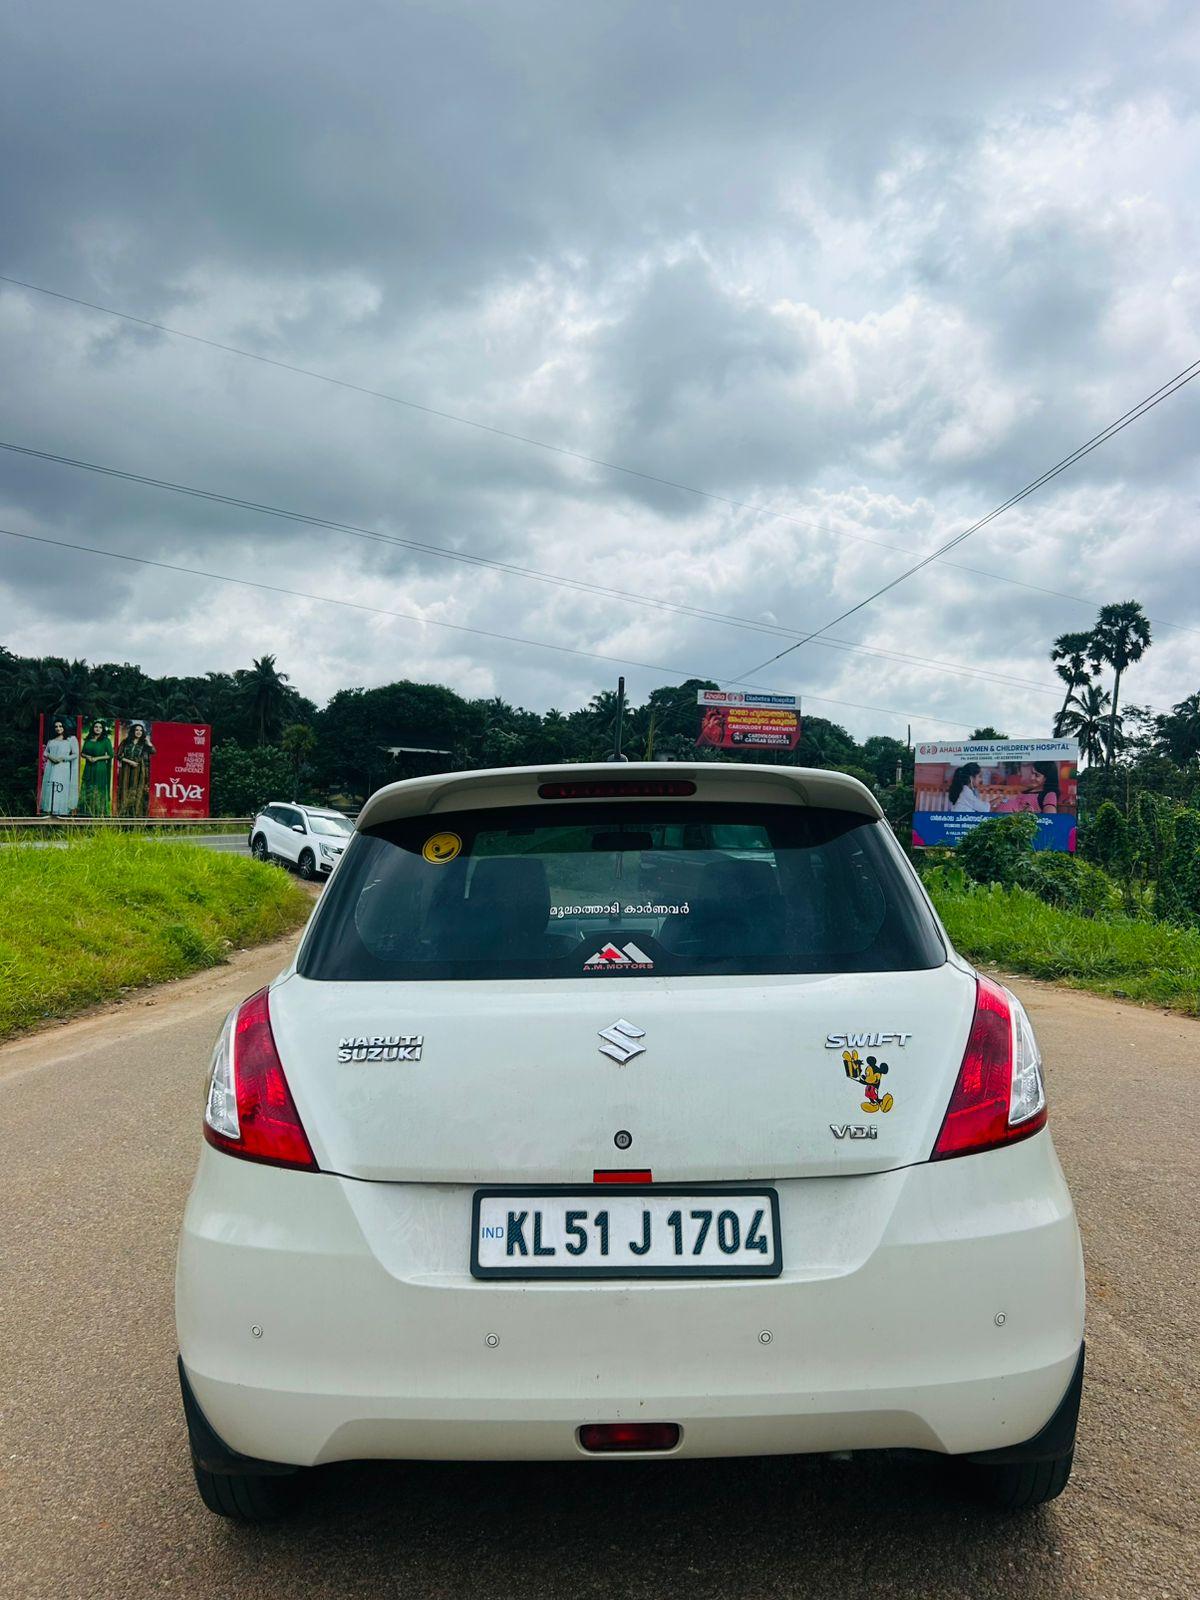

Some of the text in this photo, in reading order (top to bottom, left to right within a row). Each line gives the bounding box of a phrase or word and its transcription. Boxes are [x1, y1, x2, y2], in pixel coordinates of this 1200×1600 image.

[996, 744, 1035, 752] CHILDREN'S
[1036, 743, 1070, 751] HOSPITAL
[154, 779, 205, 803] niya
[624, 901, 690, 914] കാർണവർ
[338, 1035, 425, 1048] MARUTI
[825, 1032, 912, 1049] SWIFT
[337, 1046, 423, 1064] SUZUKI
[481, 1225, 504, 1239] IND
[629, 1210, 650, 1255] J
[667, 1209, 768, 1255] 1704
